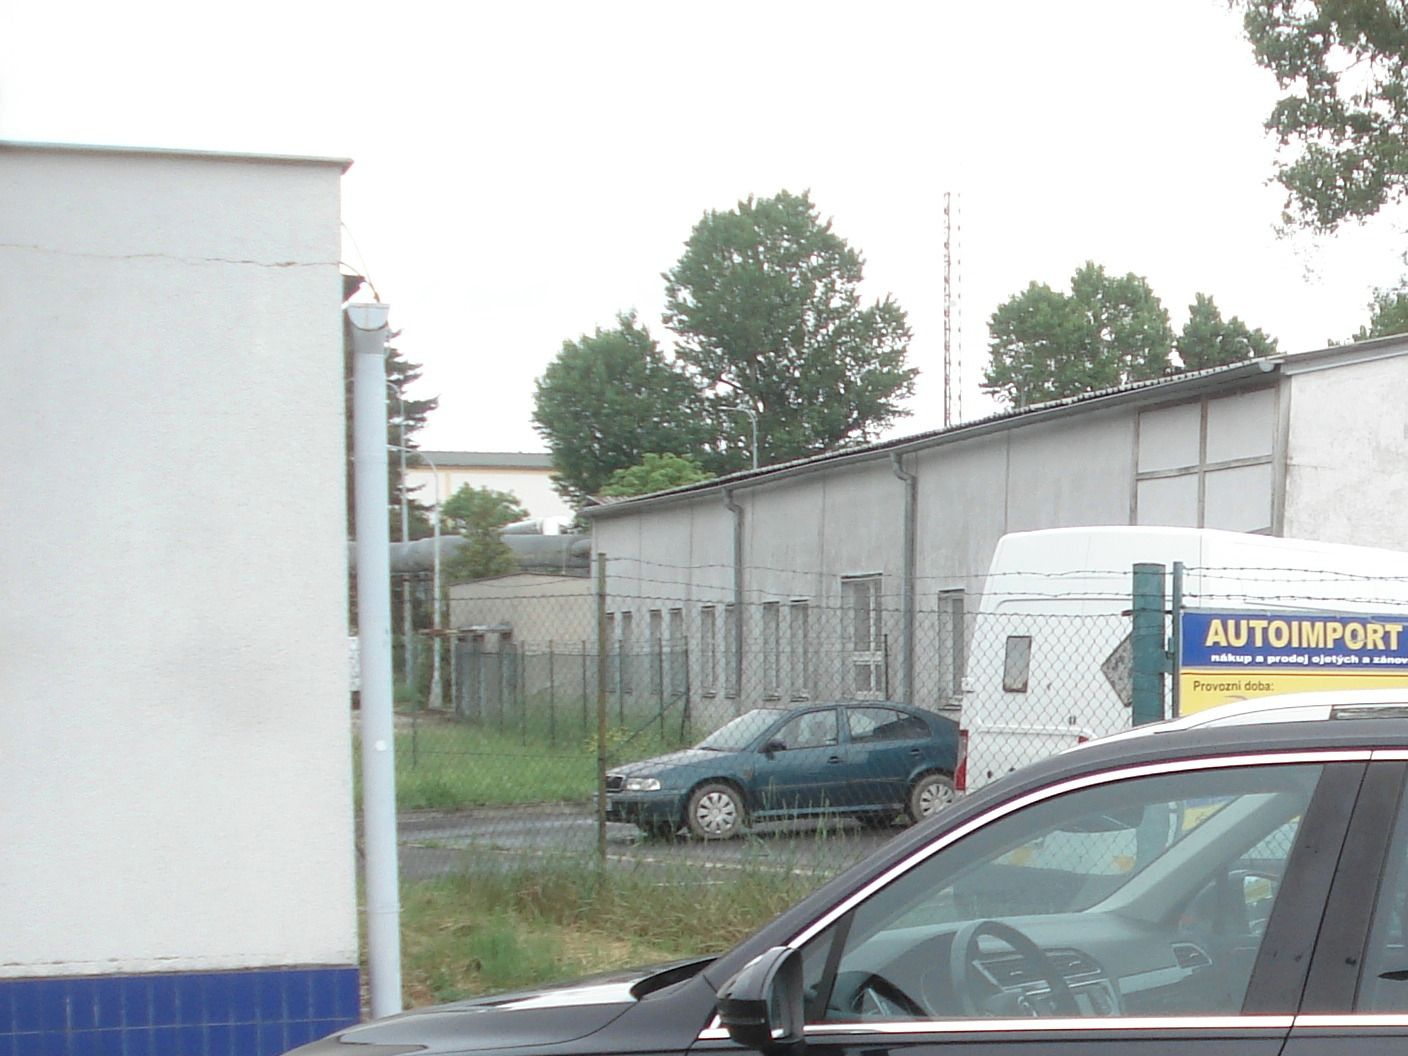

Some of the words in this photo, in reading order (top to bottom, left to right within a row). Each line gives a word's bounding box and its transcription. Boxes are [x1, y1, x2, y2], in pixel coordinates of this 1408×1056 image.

[1205, 618, 1404, 650] AUTOIMPORT
[1211, 653, 1253, 664] nákup
[1255, 654, 1264, 663] a
[1266, 653, 1309, 665] prodej
[1311, 653, 1359, 666] ojetých
[1362, 655, 1370, 664] a
